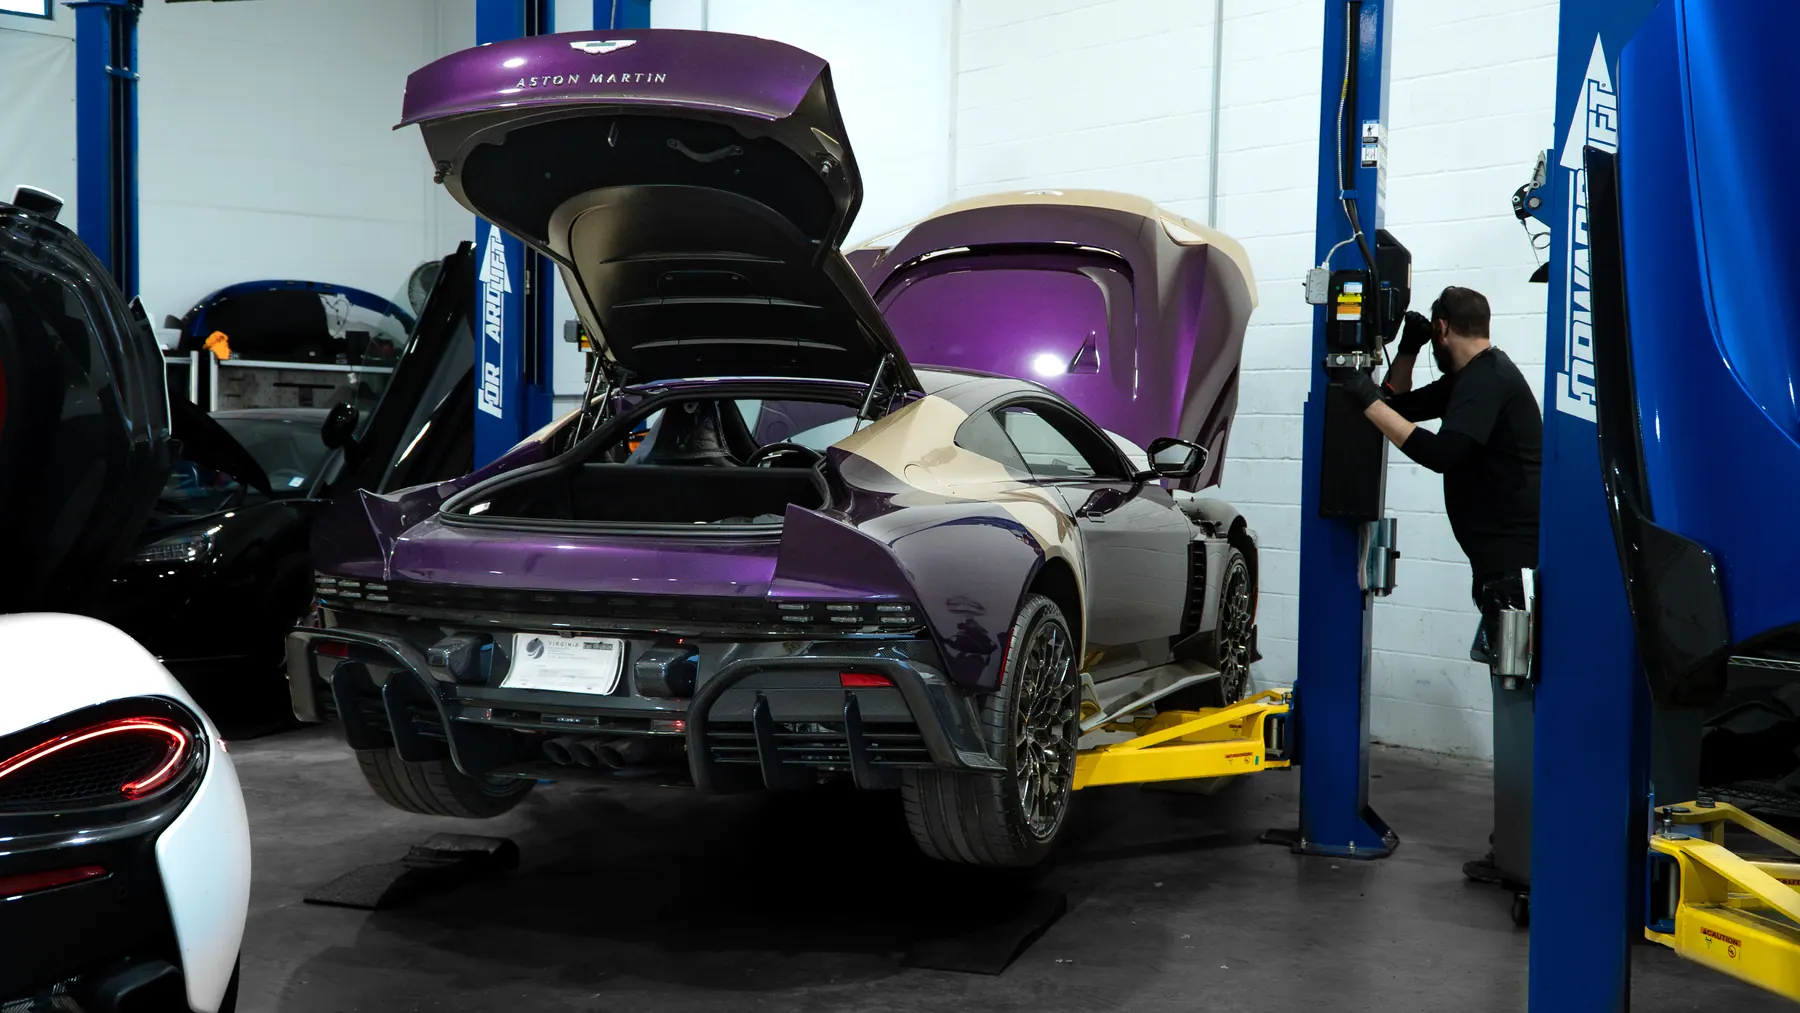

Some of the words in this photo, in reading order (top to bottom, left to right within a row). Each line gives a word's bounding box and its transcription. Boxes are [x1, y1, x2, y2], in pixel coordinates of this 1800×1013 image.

[516, 74, 580, 89] ASTON
[589, 73, 667, 84] MARTIN
[548, 640, 579, 648] VIRGINIA
[1706, 930, 1738, 946] CAUTION
